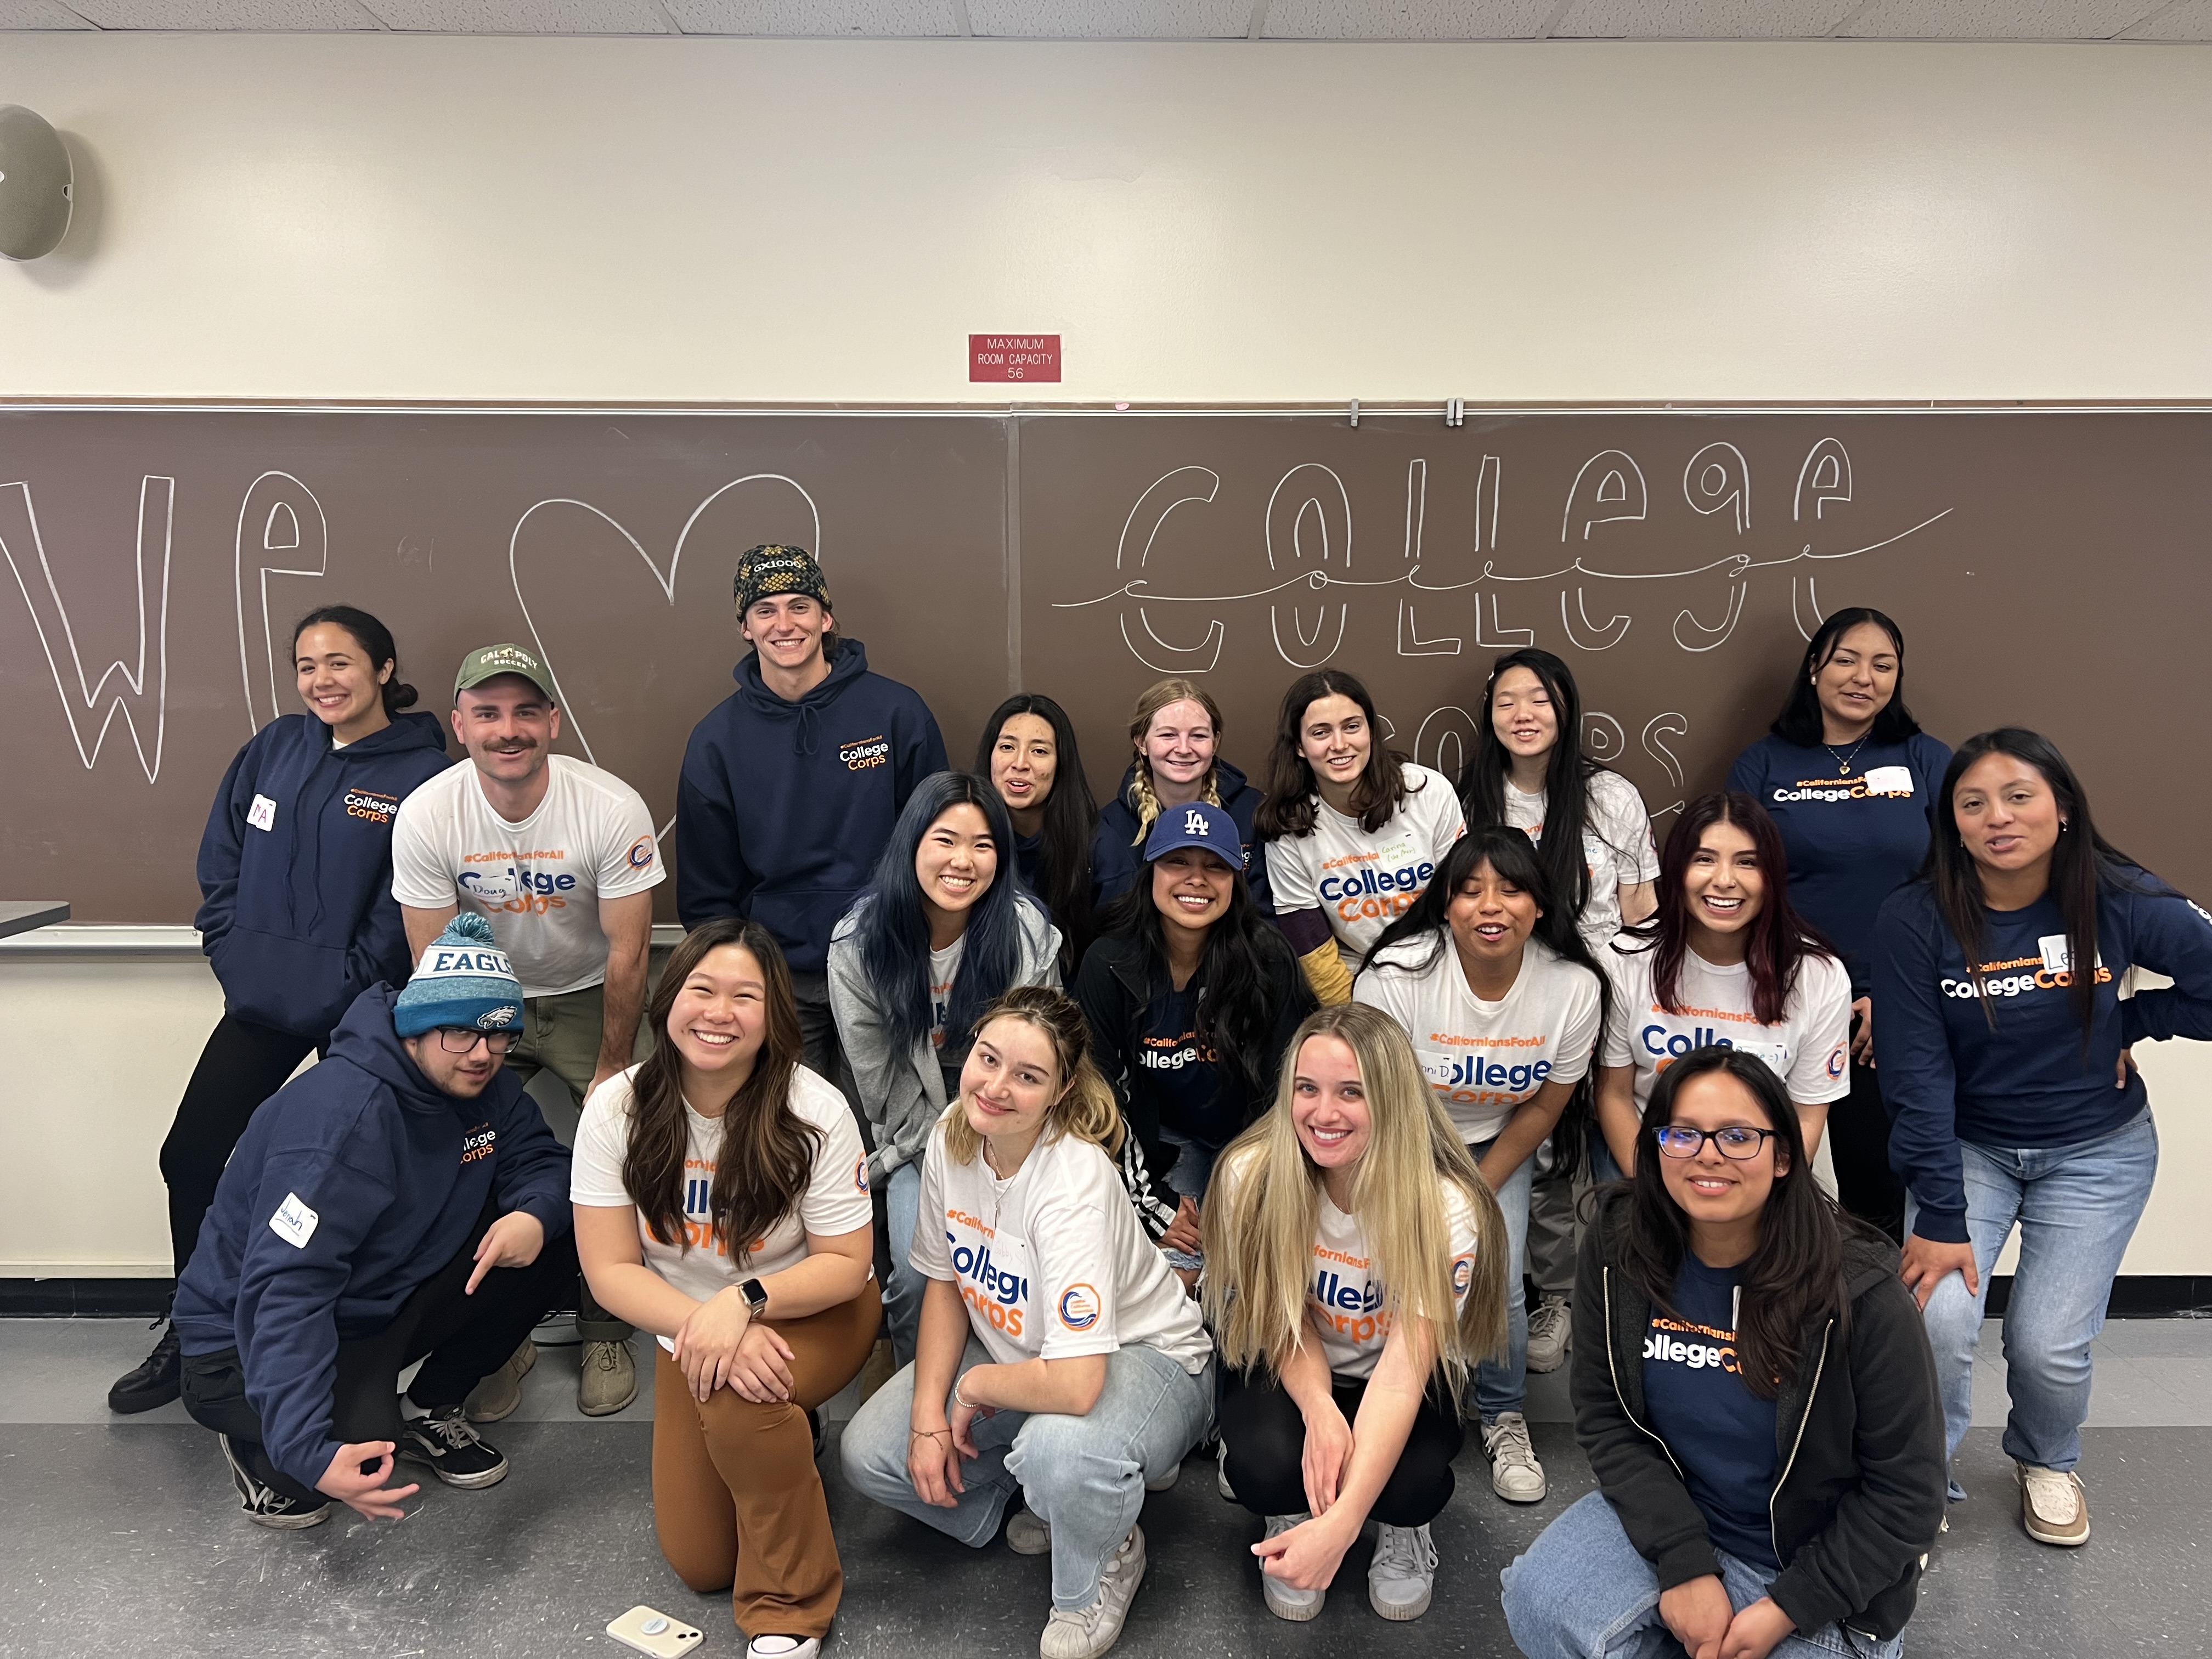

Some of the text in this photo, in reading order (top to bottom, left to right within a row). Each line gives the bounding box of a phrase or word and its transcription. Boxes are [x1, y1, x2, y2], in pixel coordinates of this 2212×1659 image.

[987, 338, 1044, 349] MAXIMUM
[978, 353, 1053, 365] ROOM CAPACITY
[1007, 368, 1024, 379] 56
[754, 560, 802, 572] GX1000
[480, 651, 538, 669] CAL POLY
[494, 659, 527, 669] SOCCER
[839, 743, 889, 762] College
[848, 754, 887, 771] Corps
[343, 793, 397, 815] College
[347, 805, 389, 823] Corps
[1184, 810, 1209, 836] LA
[1322, 851, 1380, 870] #California
[1319, 862, 1434, 901] College
[473, 884, 507, 899] Doug
[1430, 1032, 1546, 1048] #CaliforniansForAll
[1449, 1056, 1553, 1093] ollege
[463, 1130, 496, 1152] llege
[461, 1144, 494, 1164] orps
[946, 1209, 995, 1240] #Californ
[946, 1231, 1028, 1305] olleg
[953, 1271, 1024, 1338] orps
[1642, 1334, 1743, 1376] ollegeC
